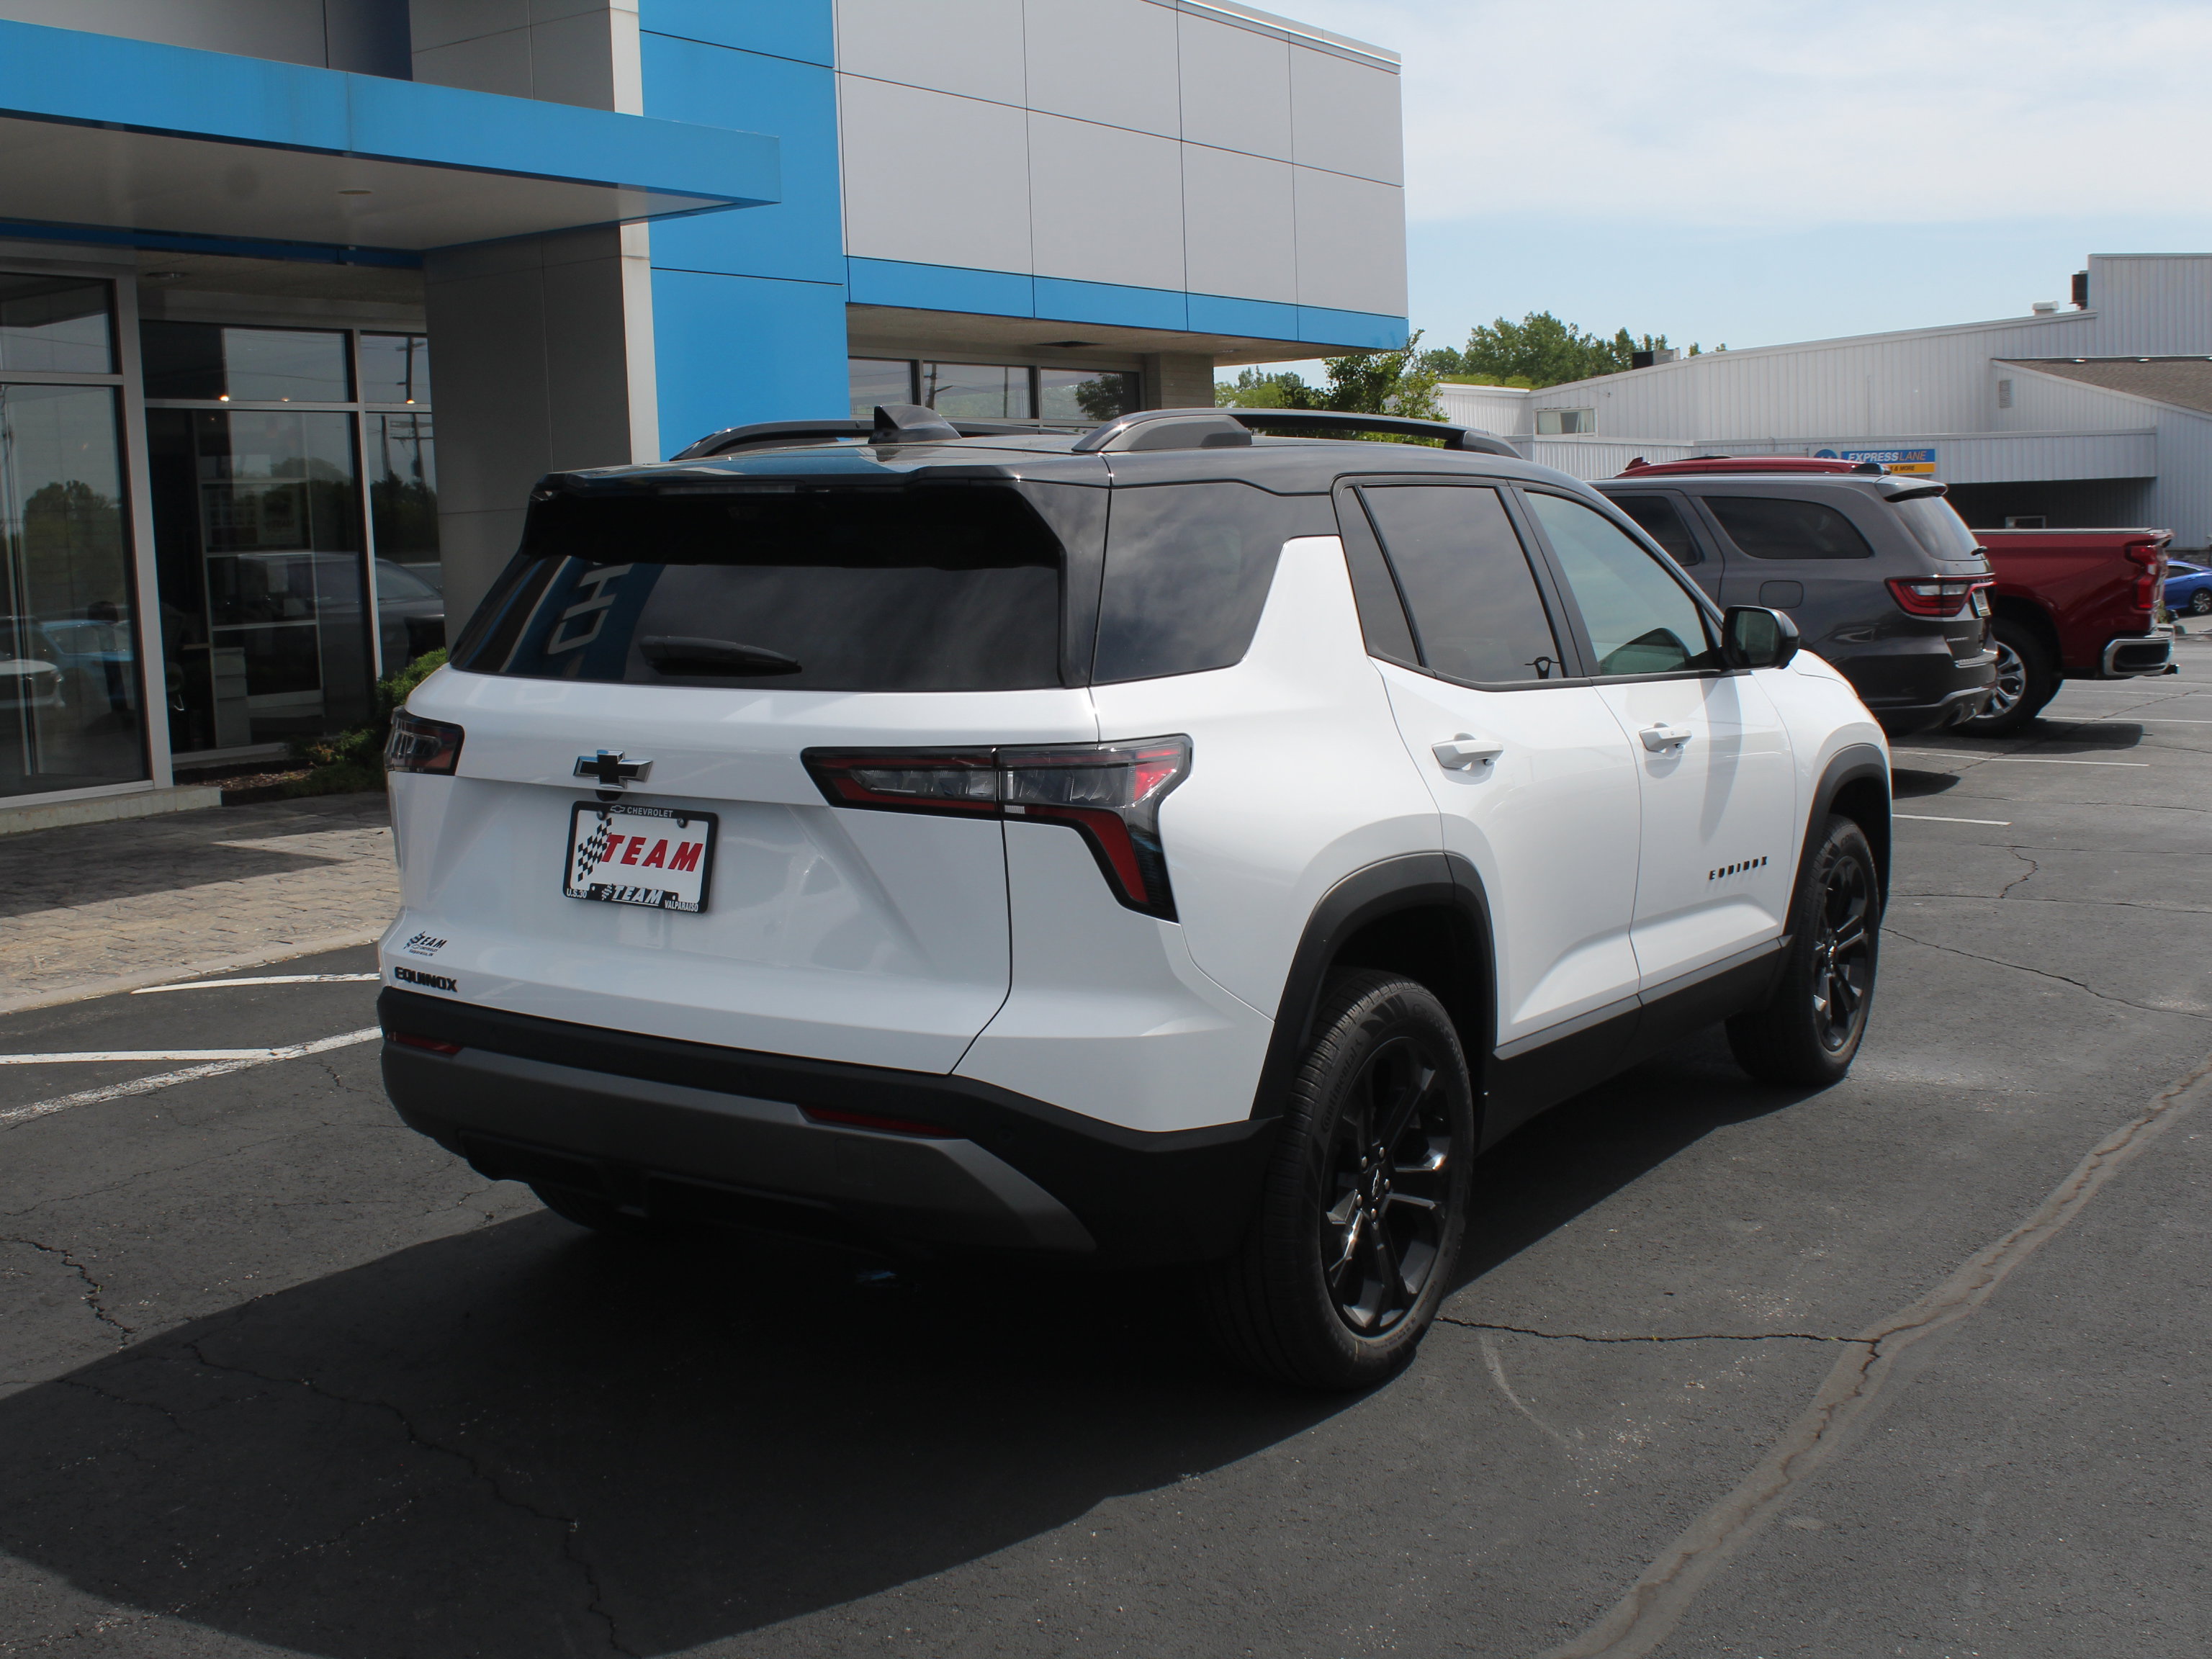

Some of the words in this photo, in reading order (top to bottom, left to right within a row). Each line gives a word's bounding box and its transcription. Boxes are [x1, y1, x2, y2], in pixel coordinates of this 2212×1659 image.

[626, 806, 673, 818] CHEVROLET
[601, 834, 703, 873] TEAM
[612, 885, 665, 905] TEAM
[665, 899, 698, 912] VALPARAISO
[394, 966, 458, 993] EQUINOX
